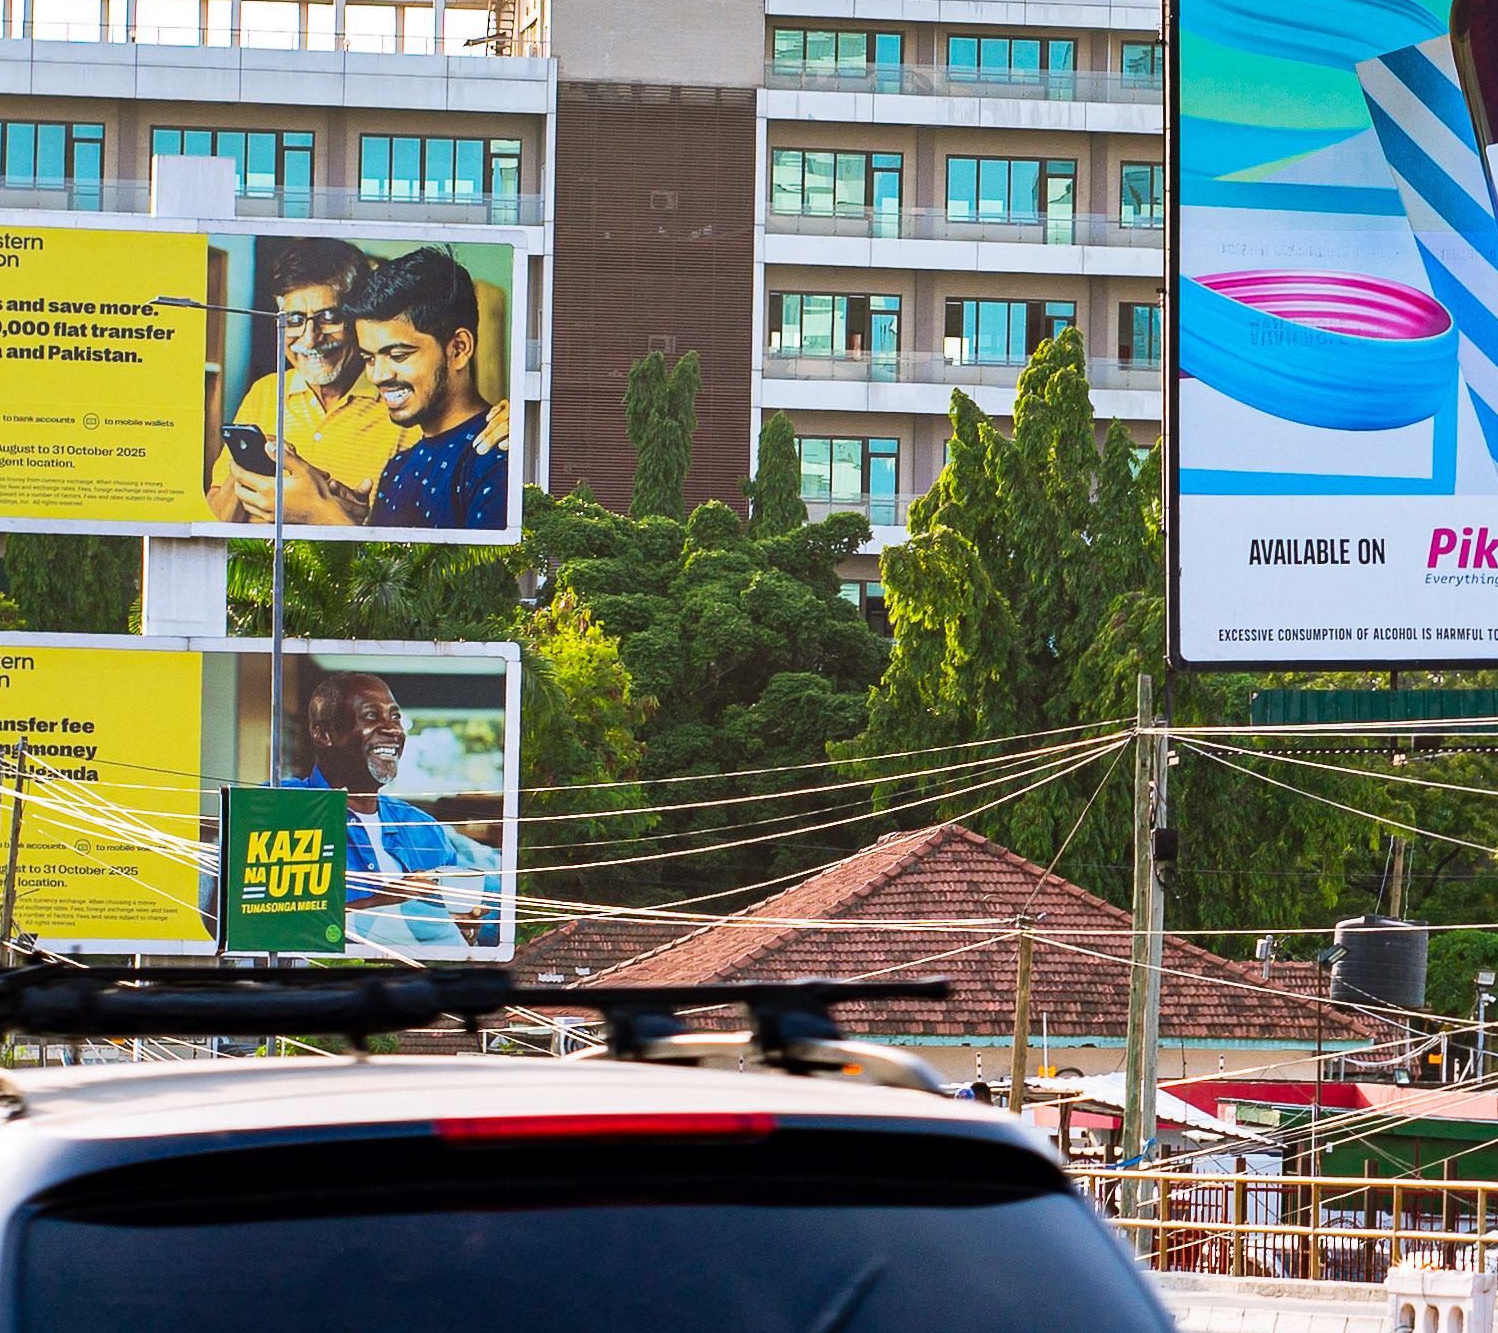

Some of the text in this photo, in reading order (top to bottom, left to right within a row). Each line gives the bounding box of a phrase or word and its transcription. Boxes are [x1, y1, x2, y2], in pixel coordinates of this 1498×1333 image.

[6, 297, 44, 313] and
[48, 301, 96, 316] save
[100, 303, 159, 317] more.
[53, 321, 88, 338] flat
[91, 323, 175, 341] transfer
[6, 344, 44, 360] and
[48, 345, 143, 364] Pakistan.
[38, 445, 49, 454] to
[52, 445, 64, 455] 31
[67, 446, 114, 457] October
[116, 447, 146, 458] 2025
[27, 457, 76, 469] location.
[1249, 537, 1385, 565] AVAILABLE ON
[1218, 628, 1273, 642] EXCESSIVE
[1278, 628, 1352, 642] CONSUMPTION
[1357, 628, 1369, 642] OF
[1373, 628, 1417, 642] ALCOHOL
[1422, 628, 1432, 642] IS
[1436, 628, 1483, 642] HARMFUL
[61, 718, 95, 734] fee
[28, 742, 97, 761] money
[247, 829, 322, 863] KAZI
[244, 863, 332, 897] NA UTU
[241, 899, 327, 914] TUNASONGA MBELE
